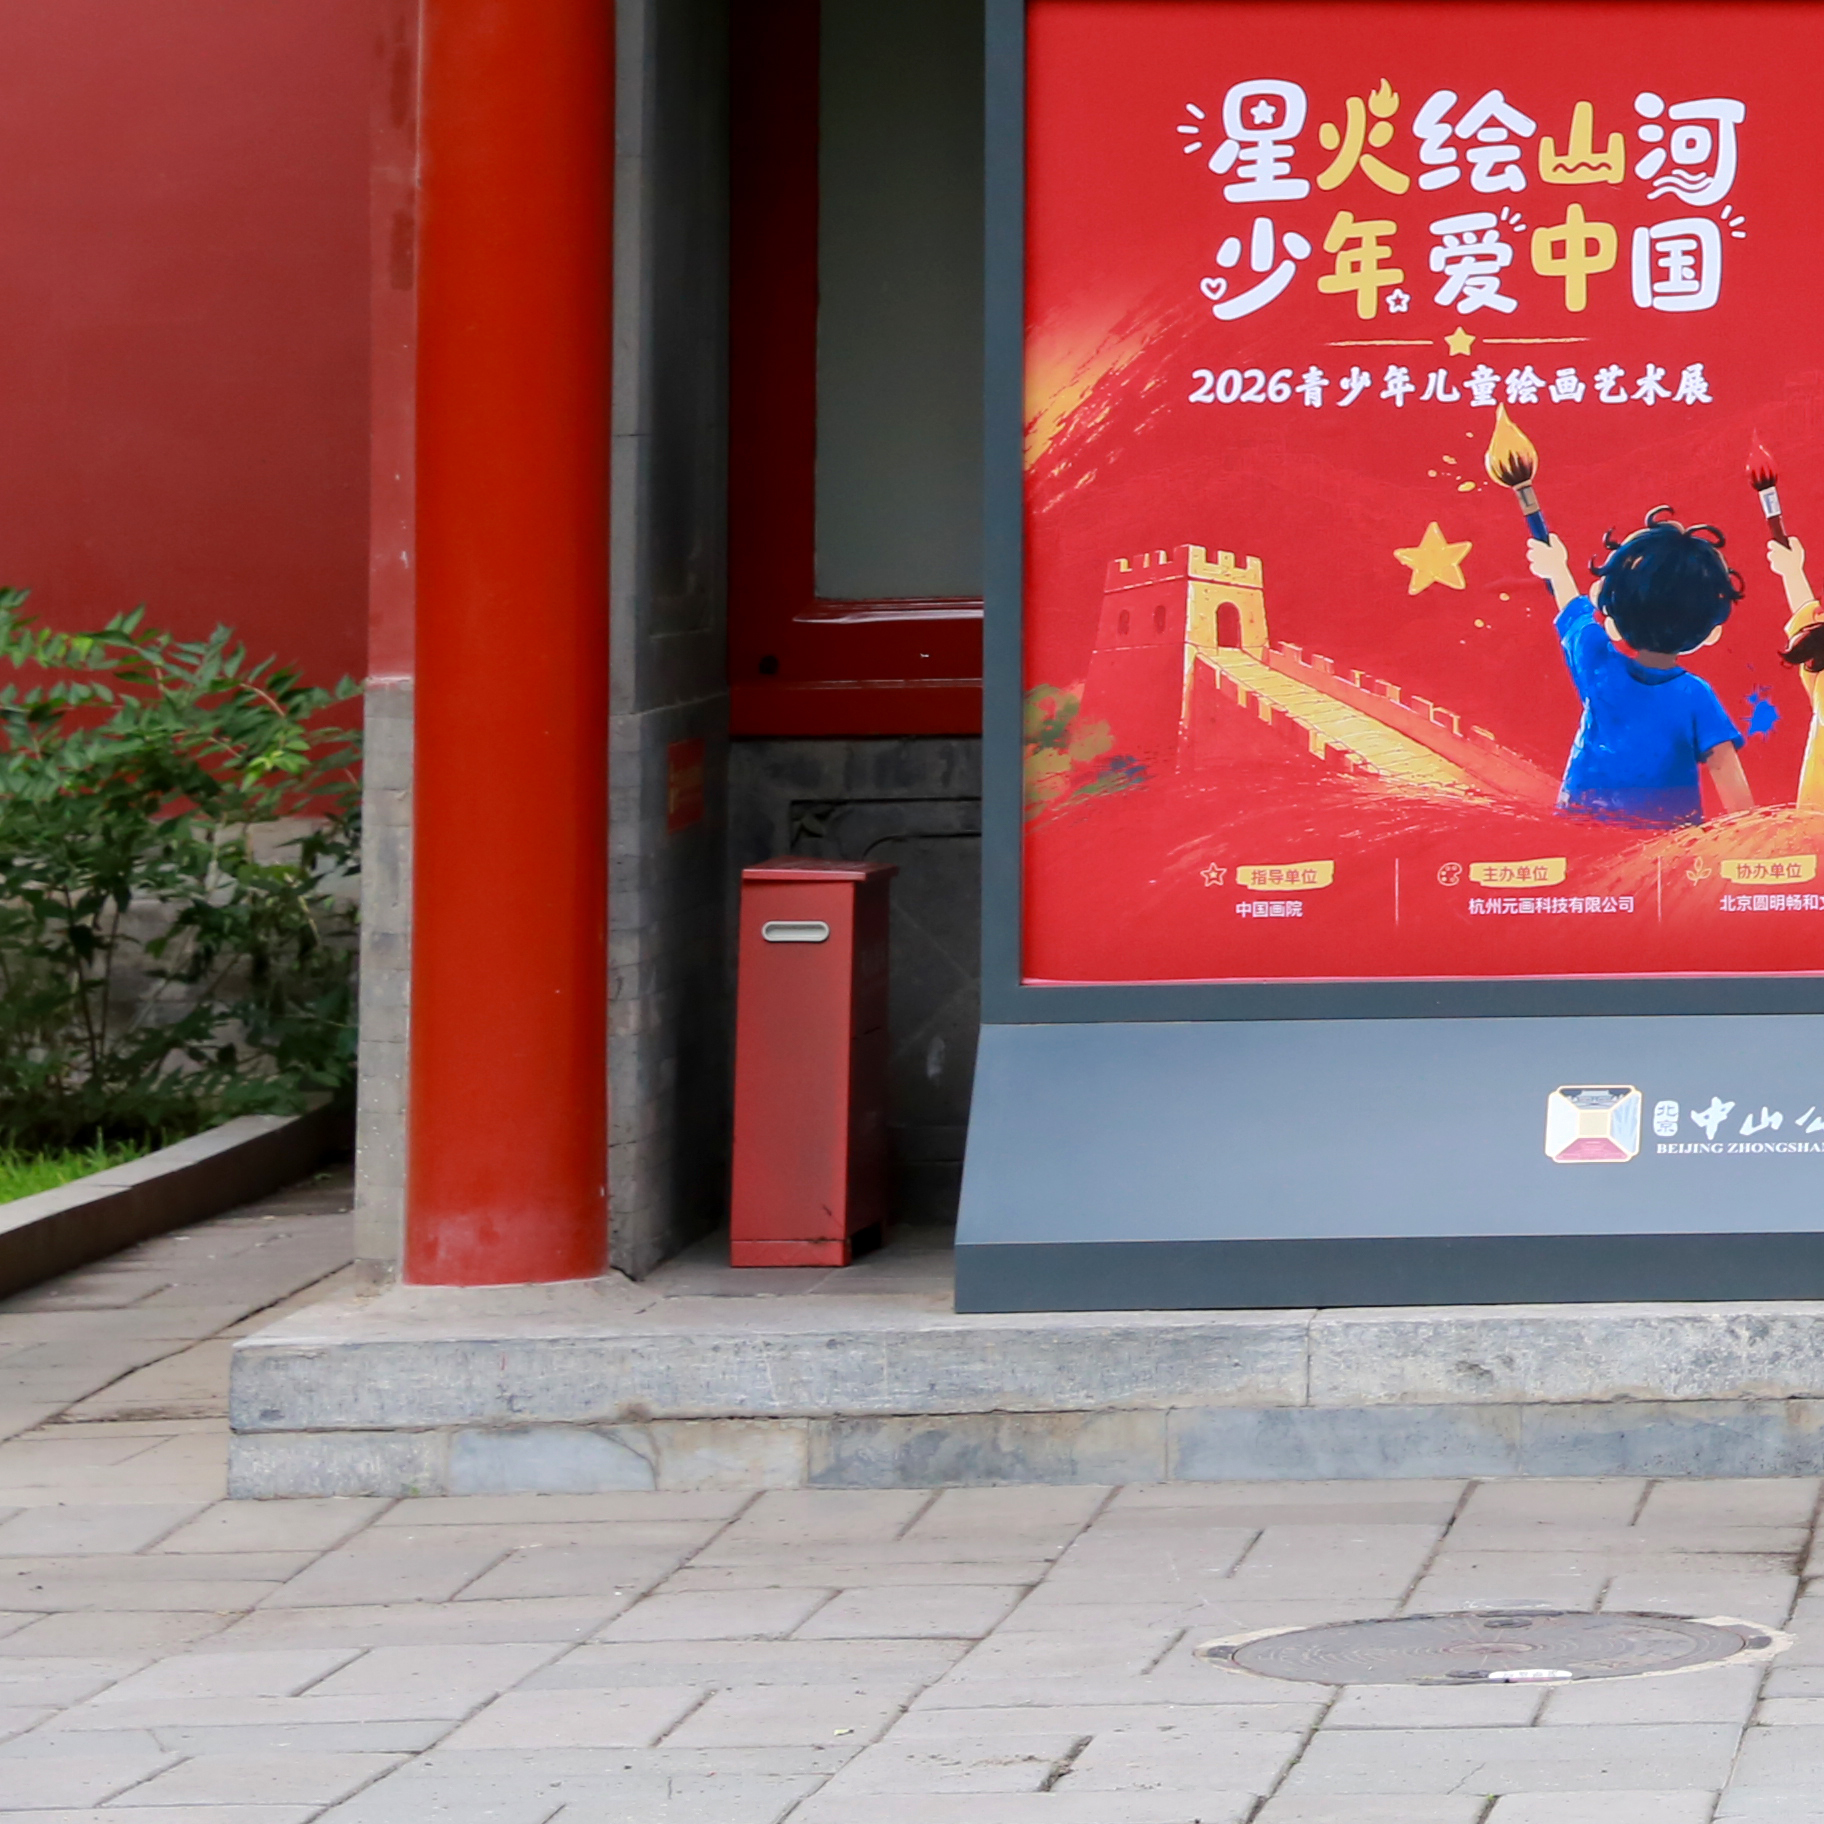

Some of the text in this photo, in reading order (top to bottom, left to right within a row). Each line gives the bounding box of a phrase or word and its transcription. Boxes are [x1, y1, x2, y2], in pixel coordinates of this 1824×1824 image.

[1209, 78, 1746, 206] 星火绘山河
[1211, 203, 1723, 320] 少年爱中国
[1188, 363, 1713, 407] 2026青少年儿童绘画艺术展
[1251, 869, 1318, 886] 指导单位
[1483, 865, 1549, 883] 主办单位
[1736, 861, 1802, 880] 协办单位
[1236, 900, 1303, 918] 中国画院
[1468, 896, 1634, 915] 杭州元画科技有限公司
[1656, 1142, 1724, 1154] BEIJING
